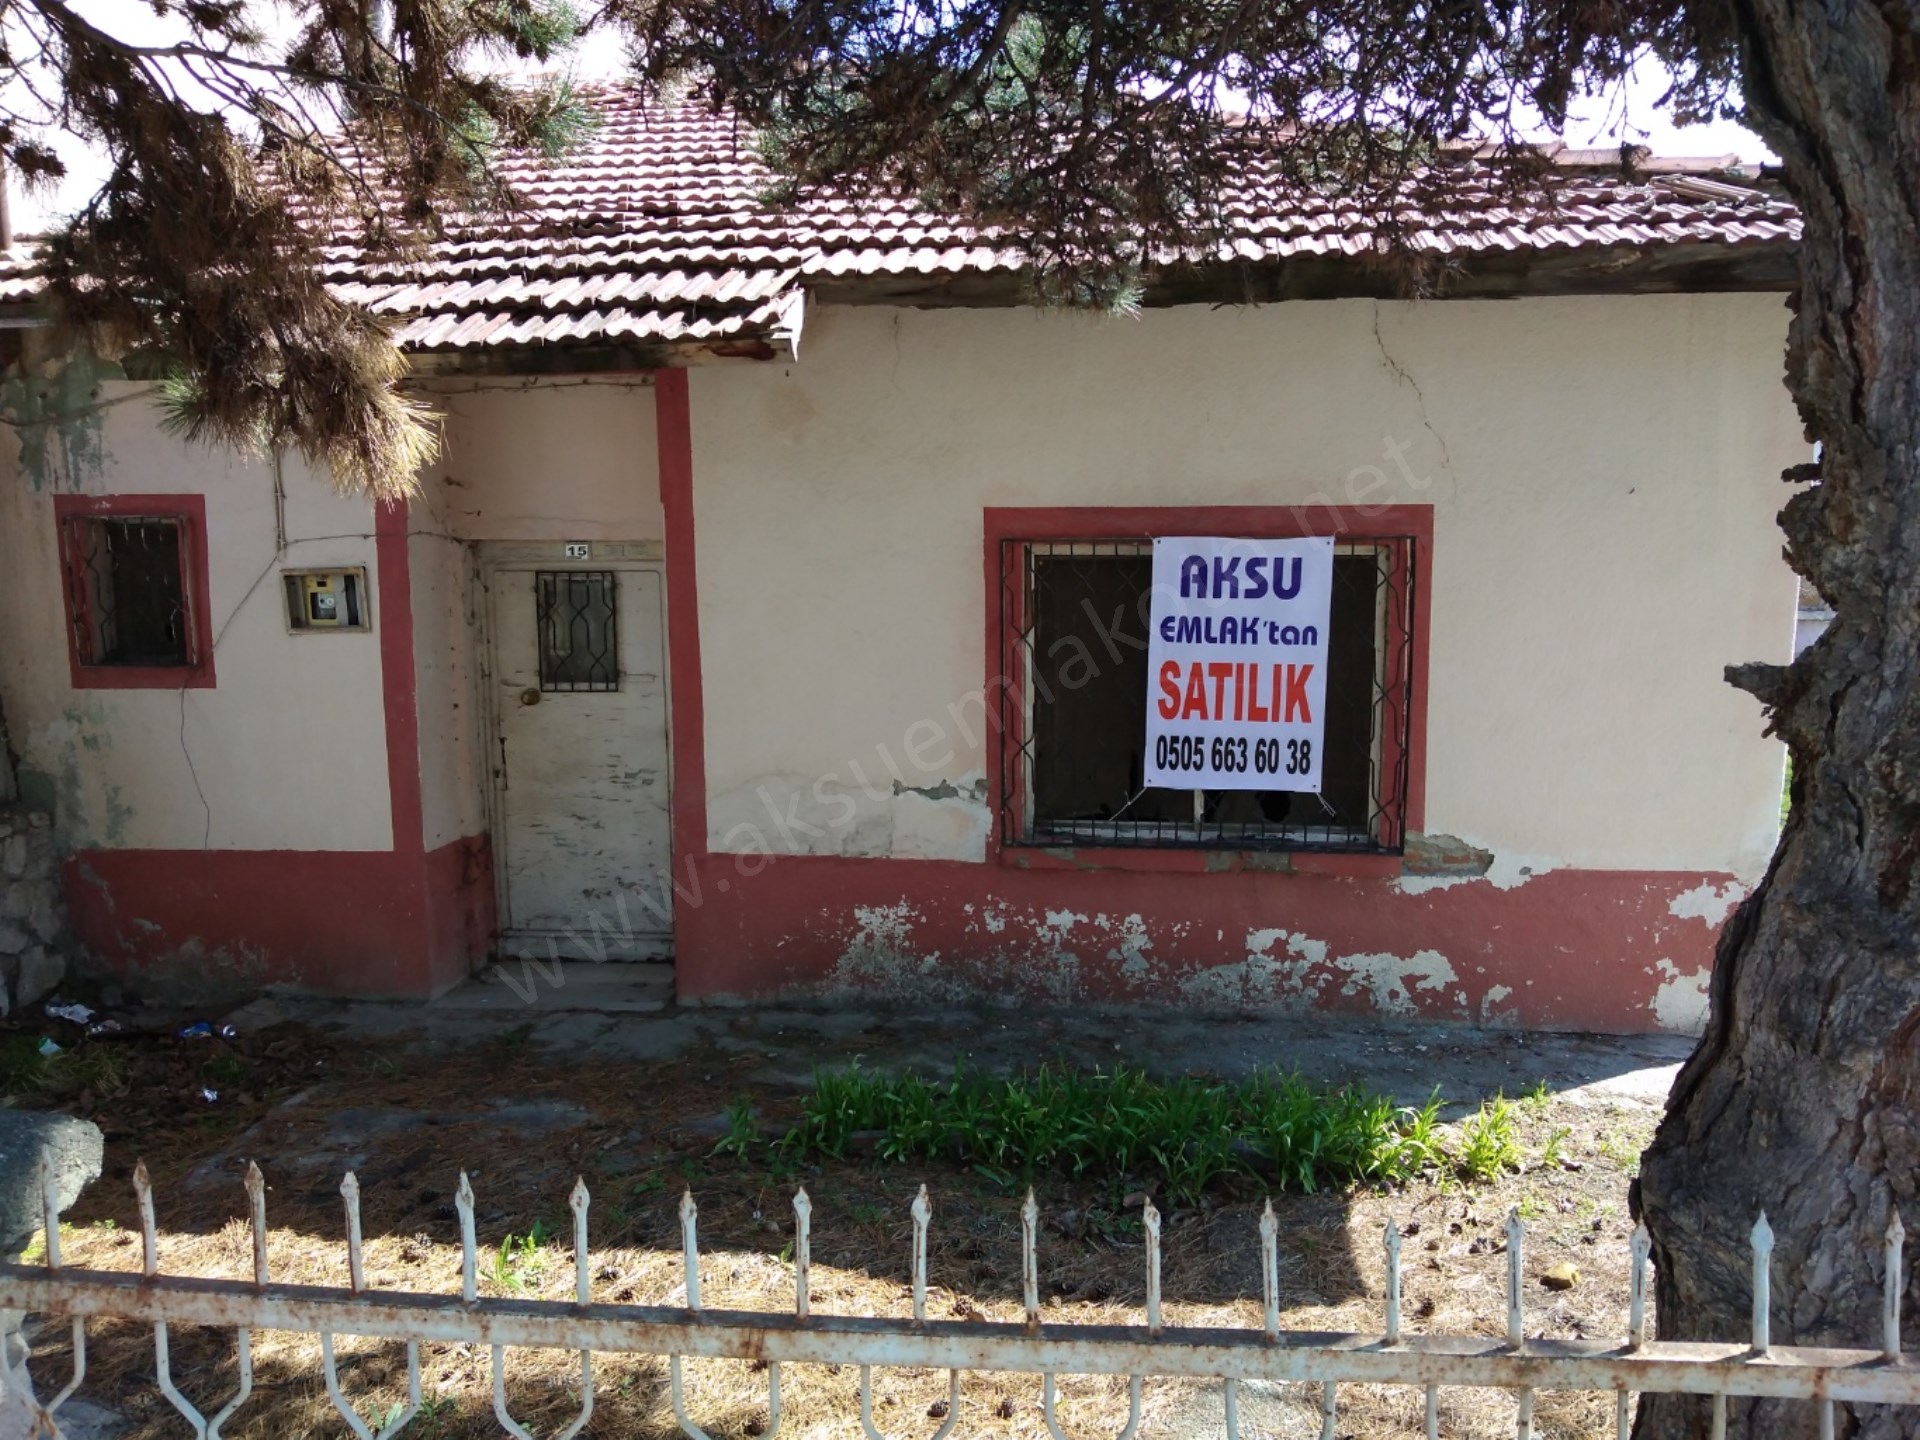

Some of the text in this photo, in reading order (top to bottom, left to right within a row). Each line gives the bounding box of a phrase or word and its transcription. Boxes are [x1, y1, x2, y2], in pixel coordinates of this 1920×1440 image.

[567, 545, 587, 556] 15
[1179, 554, 1303, 600] AKSU
[1160, 615, 1318, 646] EMLAK'tan
[1157, 659, 1314, 723] SATILIK
[1156, 734, 1311, 775] 0505 663 60 38
